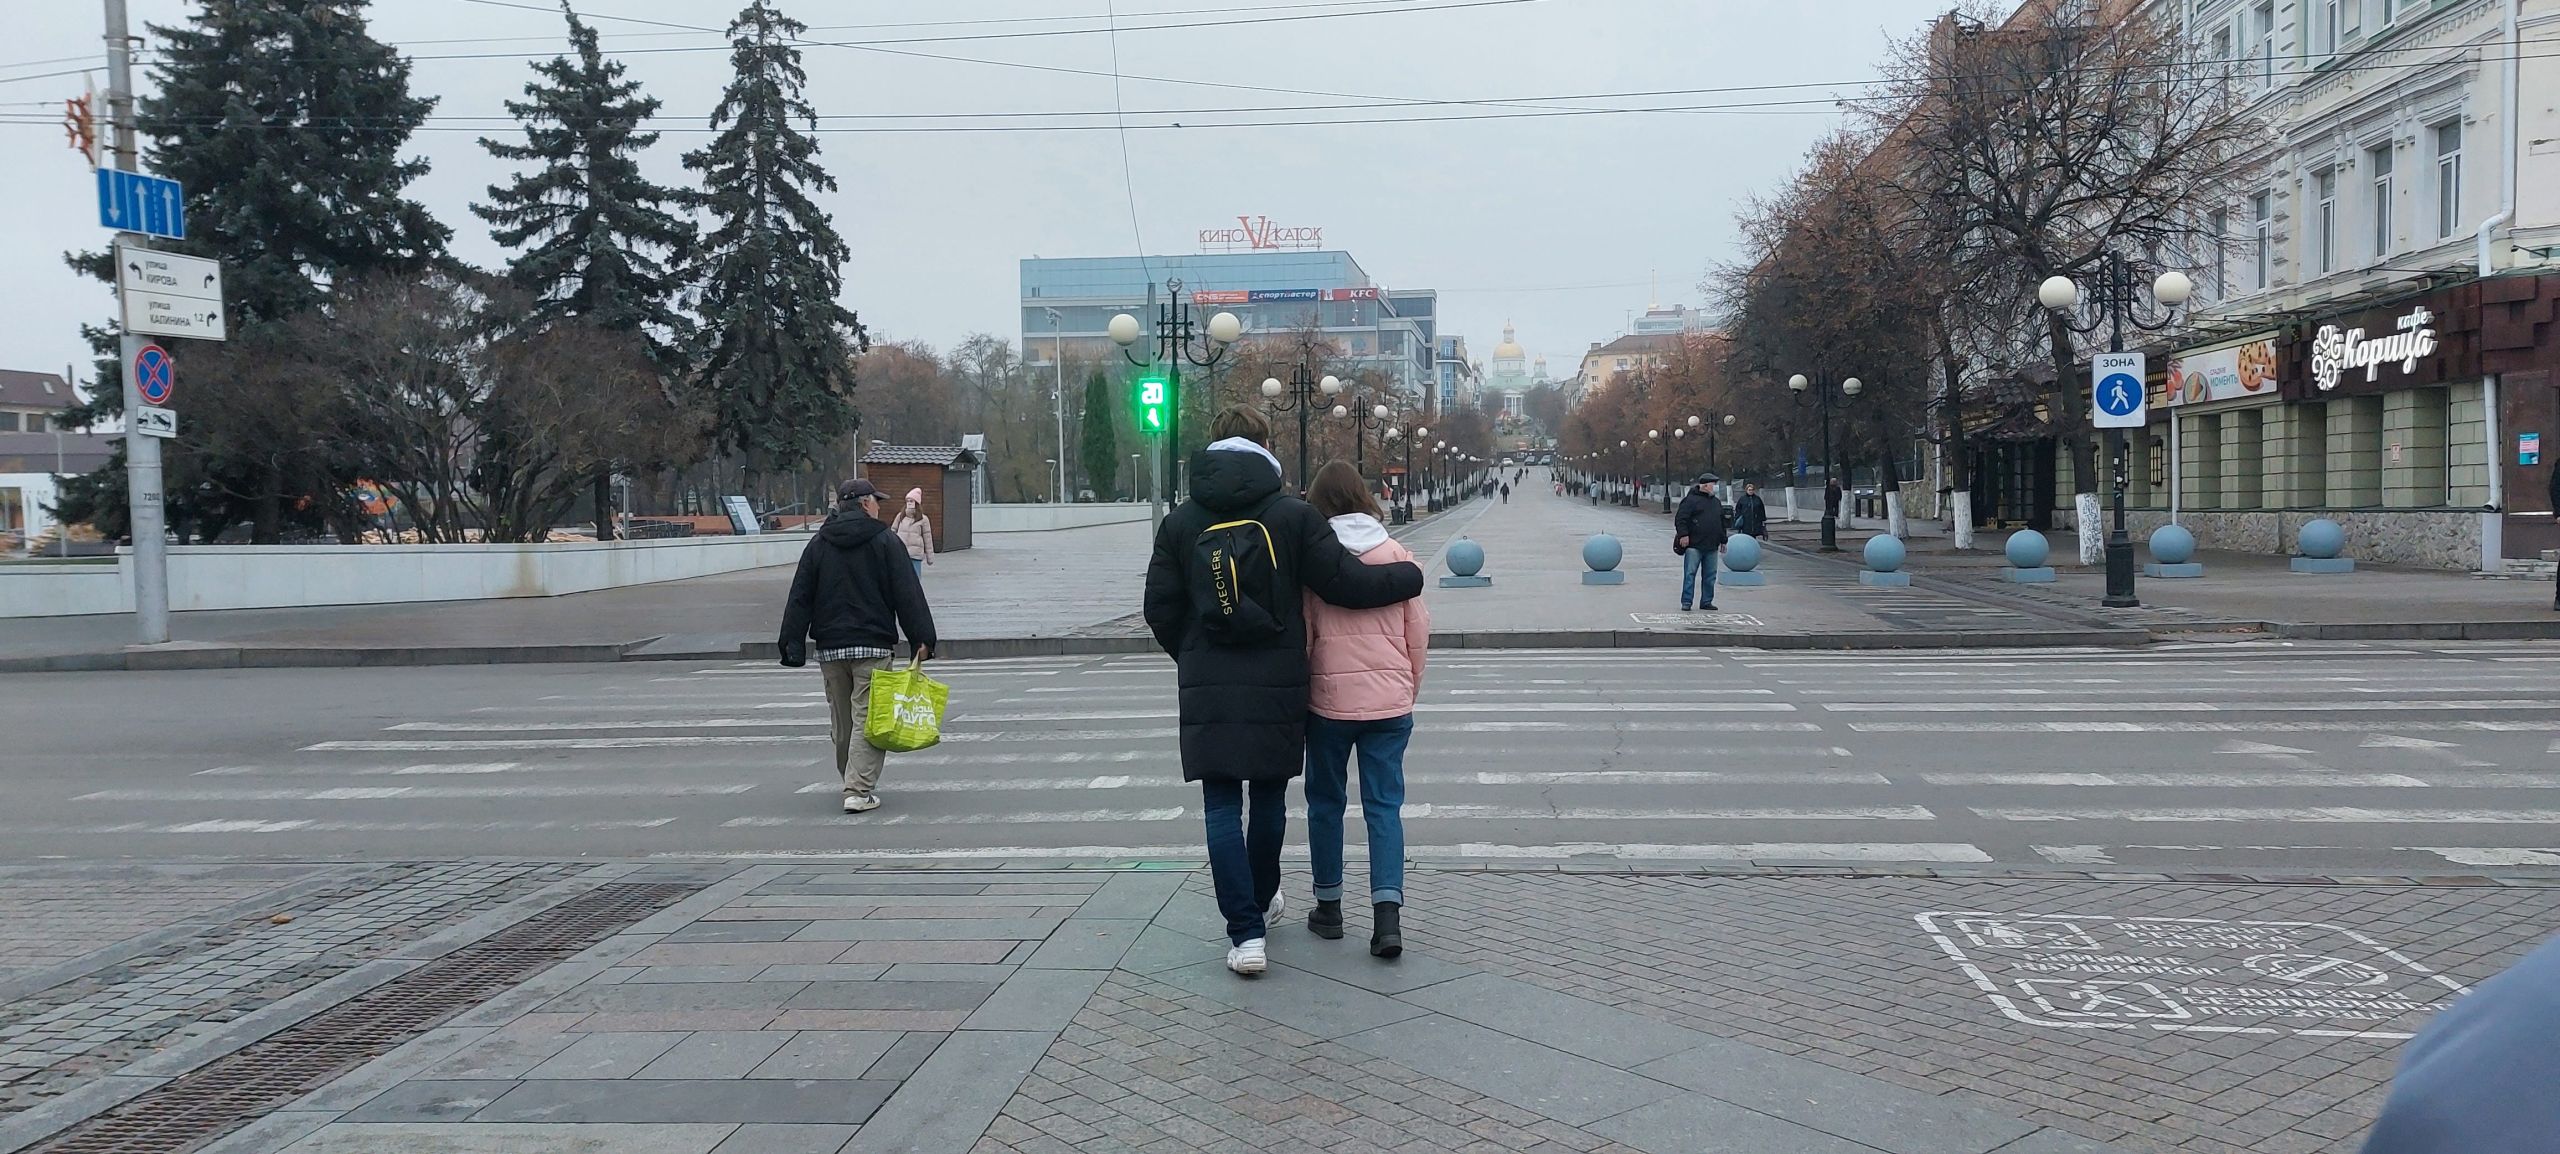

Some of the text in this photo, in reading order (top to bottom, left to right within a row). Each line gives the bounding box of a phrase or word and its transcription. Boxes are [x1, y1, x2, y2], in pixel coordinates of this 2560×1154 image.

[1199, 229, 1245, 242] КИНО
[1274, 227, 1322, 241] КАТОК
[146, 273, 178, 286] КИРОВА
[1349, 289, 1374, 298] KFC
[149, 314, 191, 326] КАЛИНИНА
[2397, 305, 2433, 333] кафе
[2342, 327, 2437, 382] Корица
[2102, 357, 2136, 368] ЗОНА
[1142, 382, 1163, 404] 20
[1211, 547, 1233, 615] SKECHERS
[2182, 996, 2455, 1011] БЕЗОПАСНОСТ
